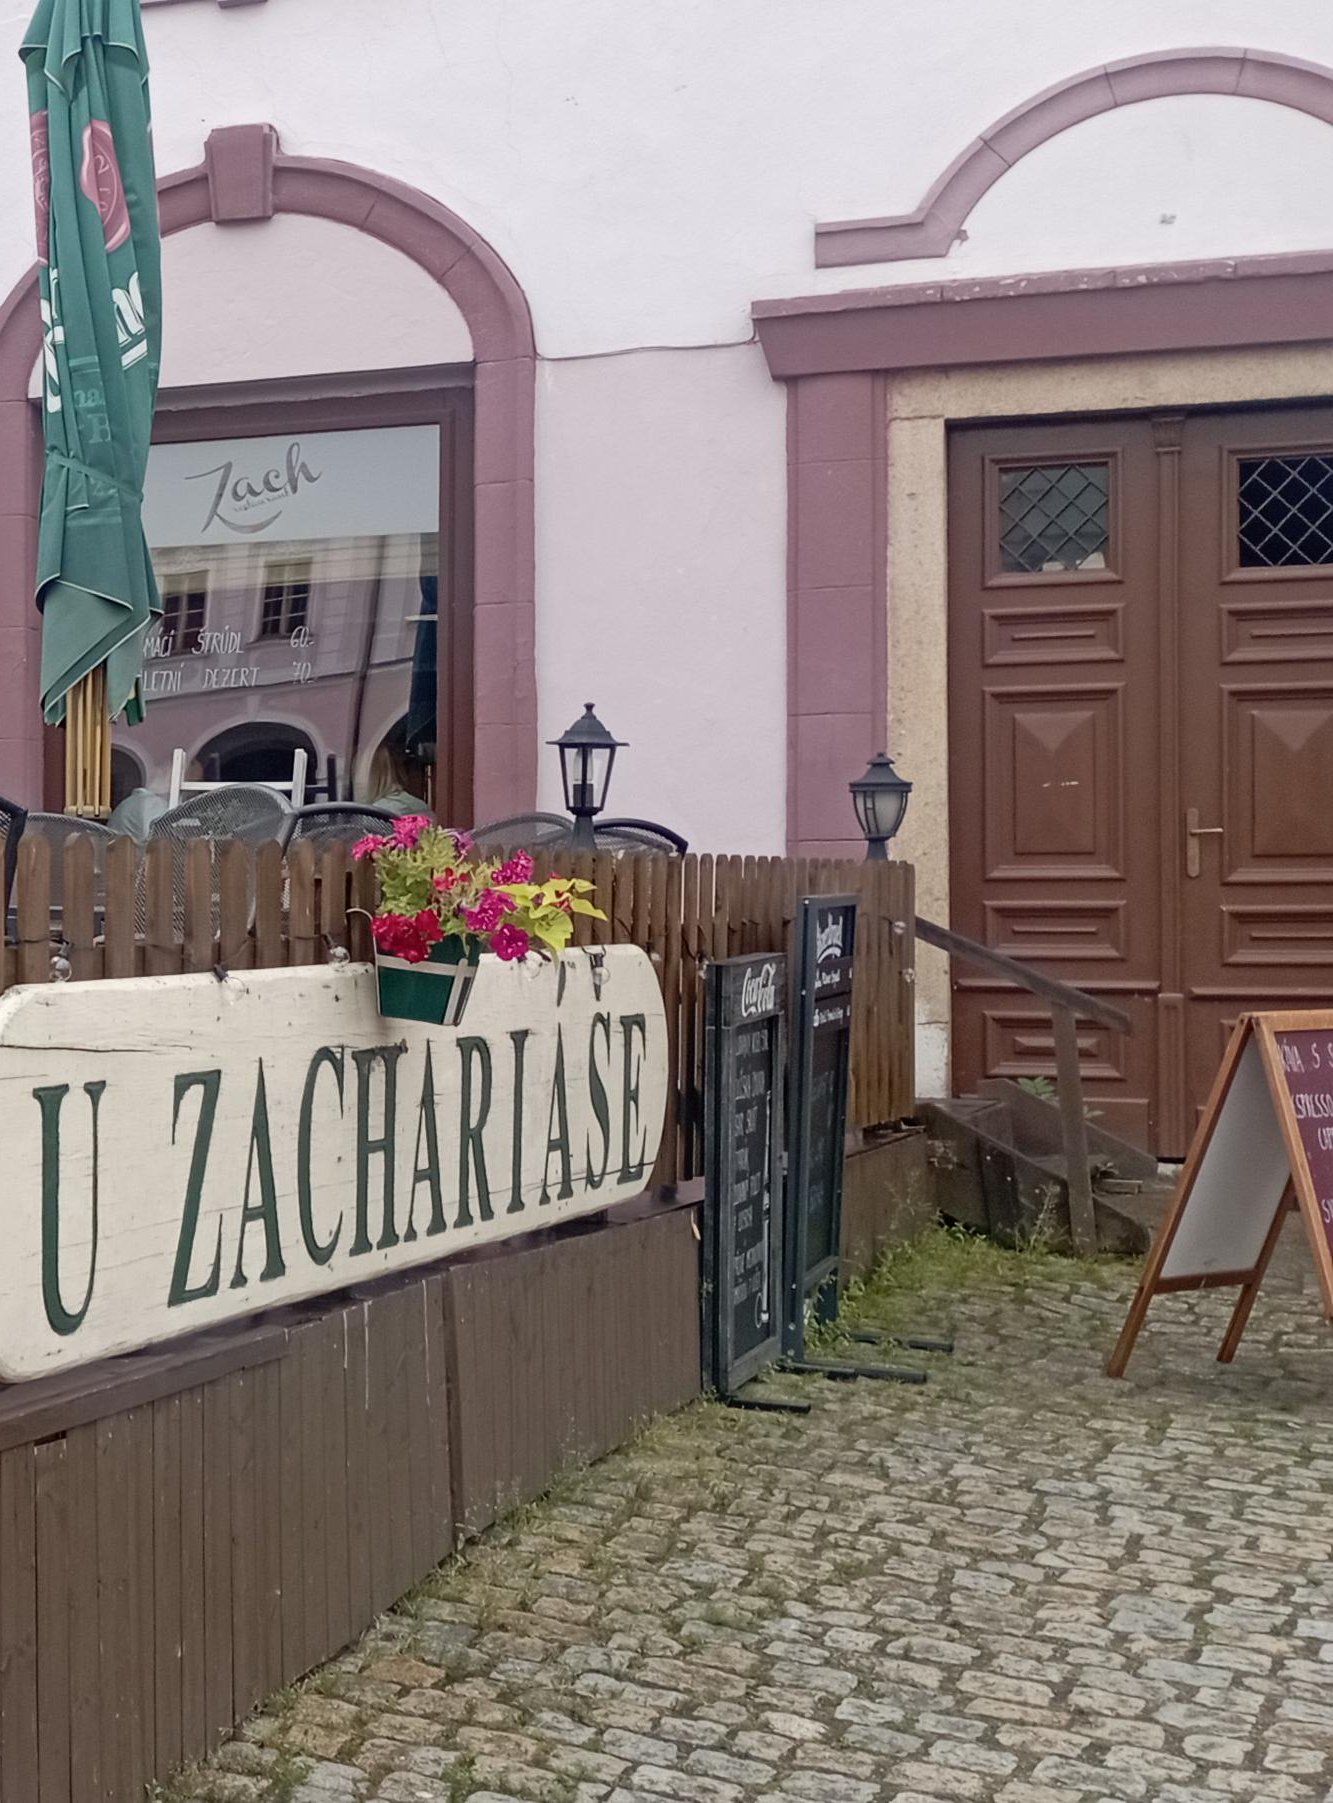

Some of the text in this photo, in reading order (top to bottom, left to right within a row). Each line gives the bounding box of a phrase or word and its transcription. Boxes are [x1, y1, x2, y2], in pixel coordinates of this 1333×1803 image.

[184, 442, 323, 533] Zach
[142, 627, 175, 657] MÁCÍ
[202, 666, 261, 690] DEZERT
[33, 1080, 106, 1336] U
